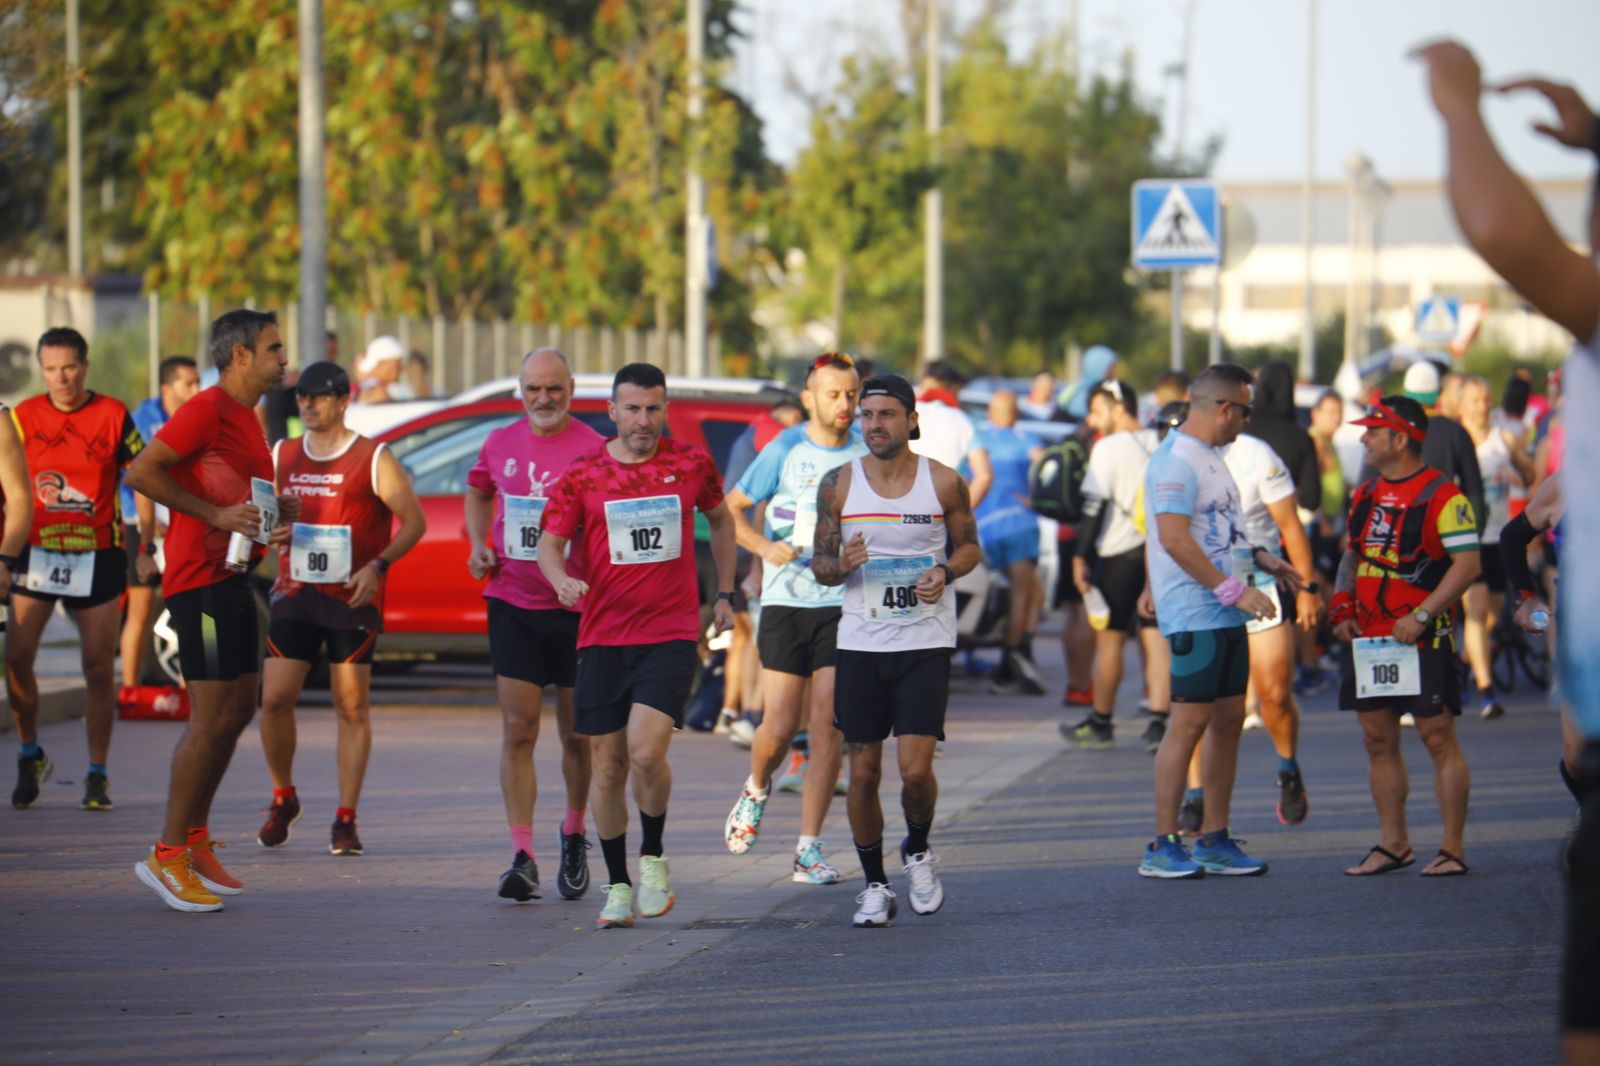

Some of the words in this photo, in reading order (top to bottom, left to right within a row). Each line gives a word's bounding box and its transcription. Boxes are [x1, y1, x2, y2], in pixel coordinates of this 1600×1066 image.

[289, 473, 344, 484] LOBOS
[1456, 503, 1473, 526] K
[521, 526, 545, 549] 16
[631, 527, 663, 551] 102
[49, 567, 72, 586] 43
